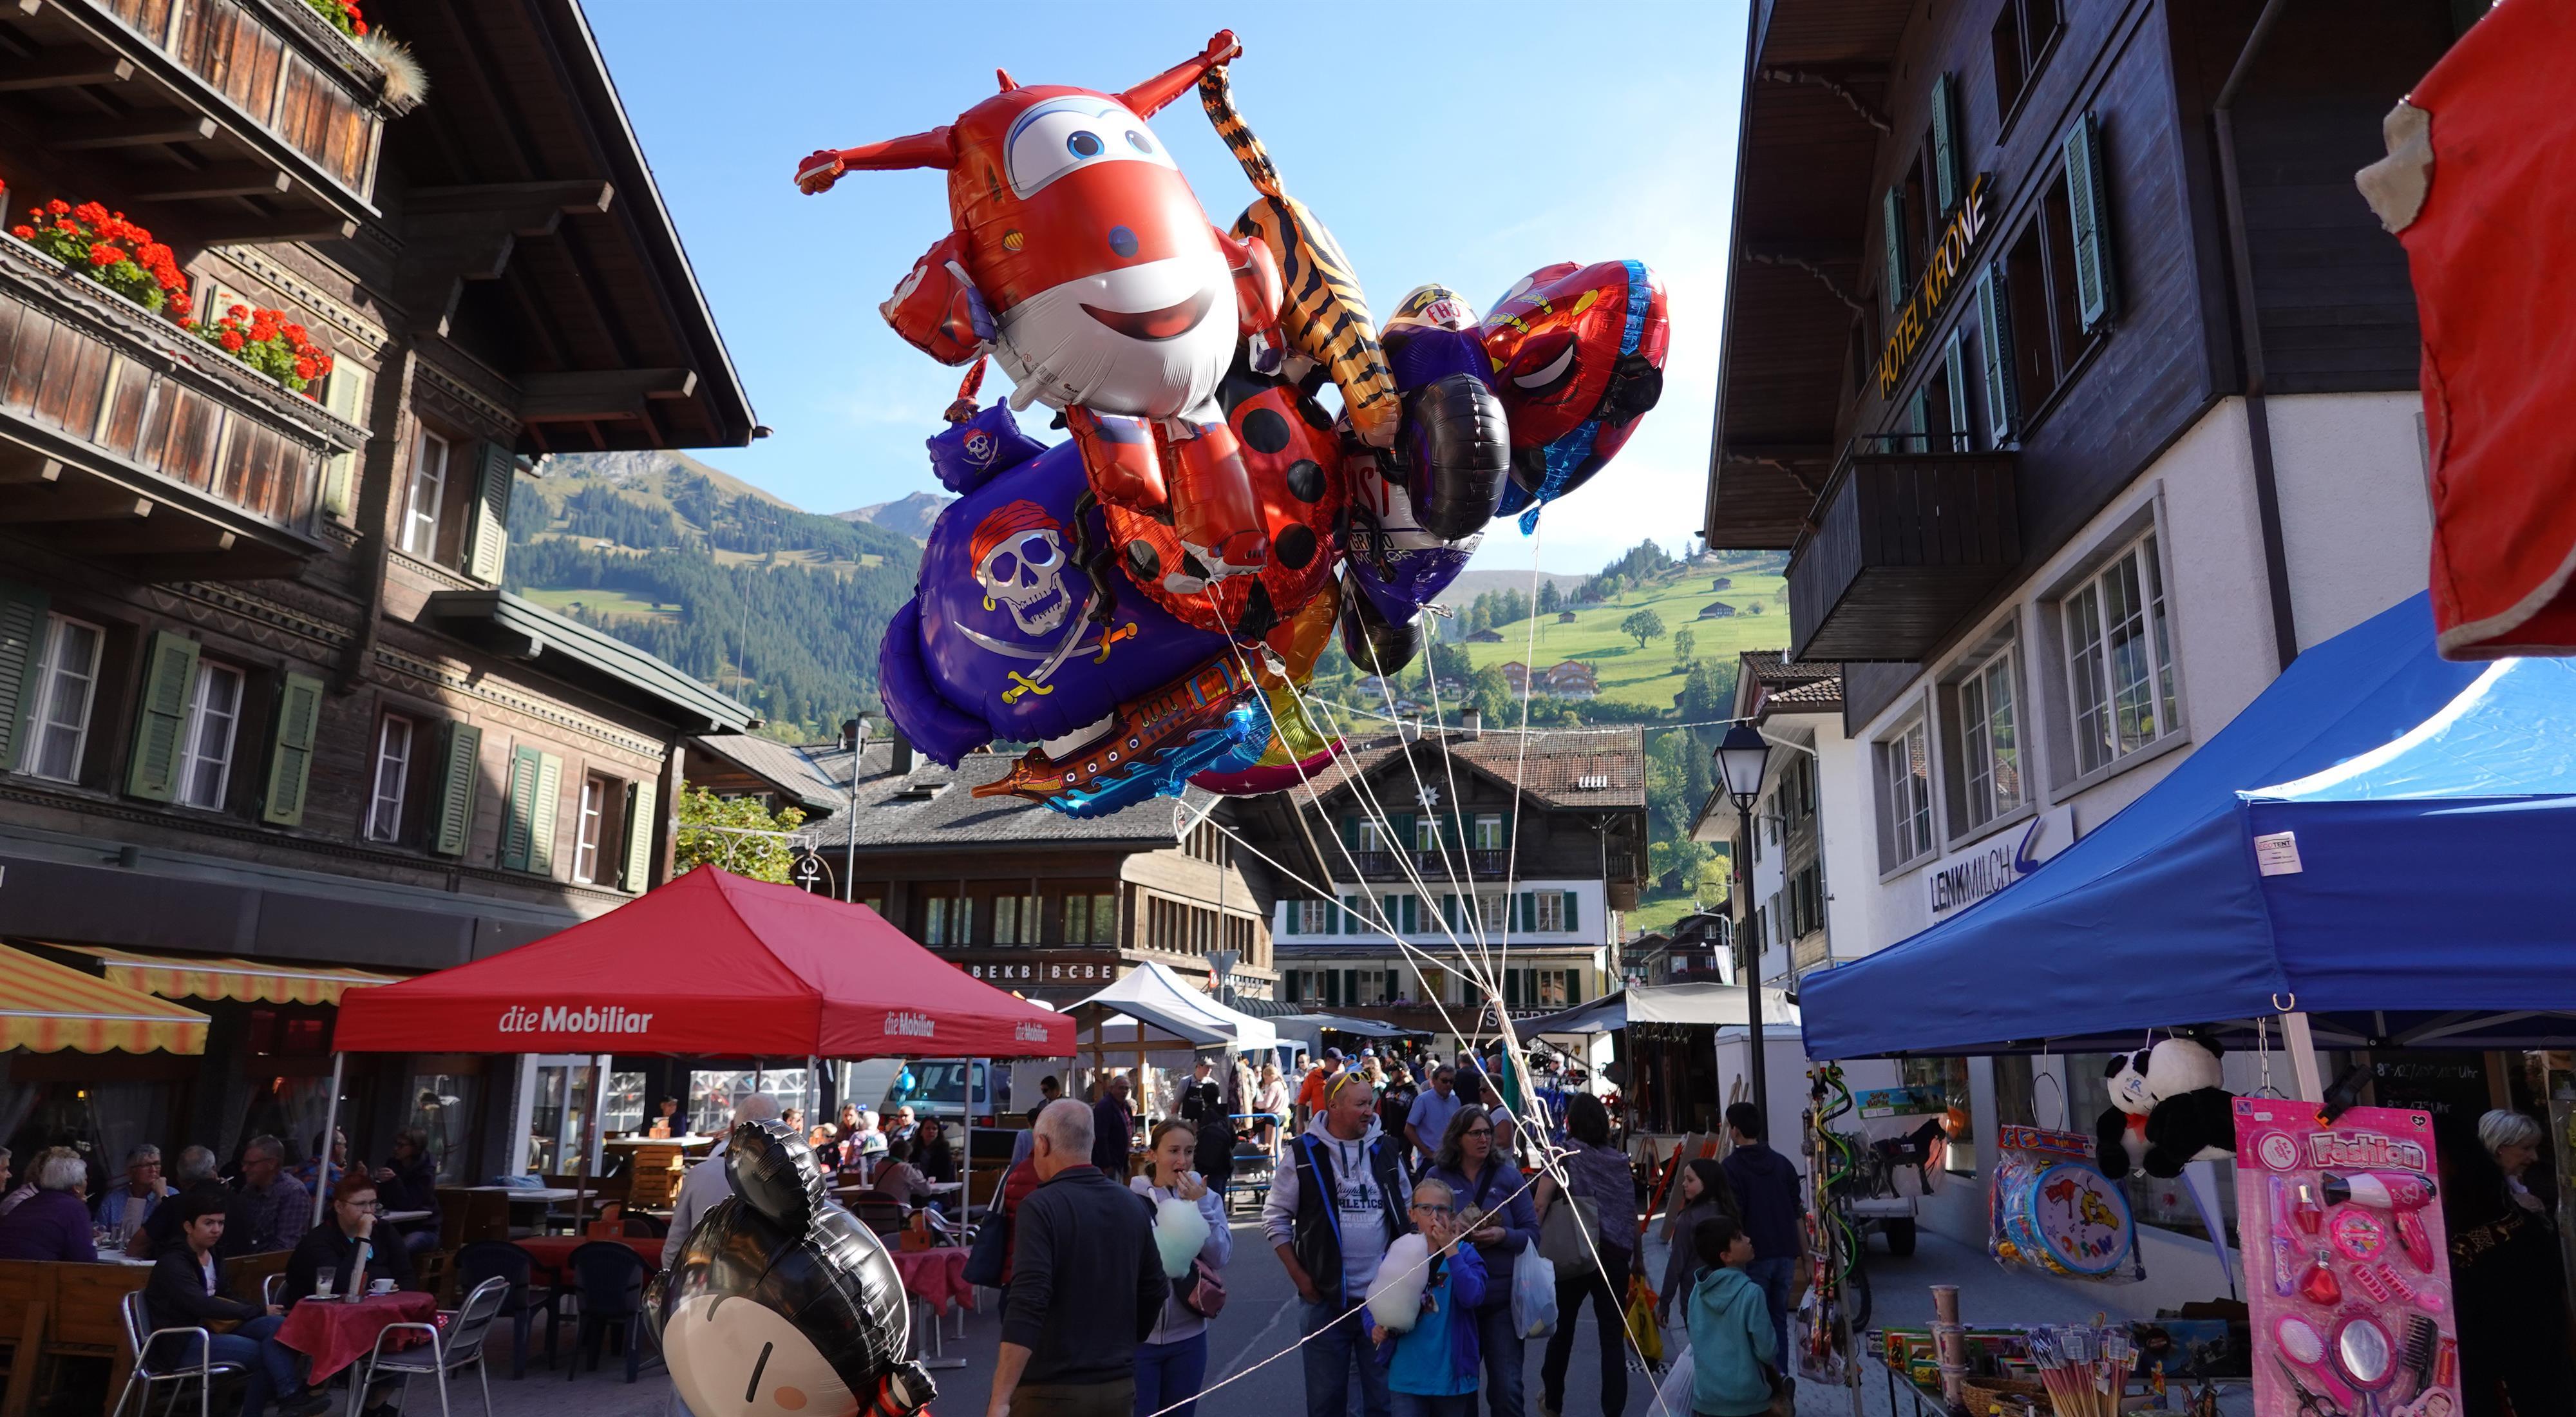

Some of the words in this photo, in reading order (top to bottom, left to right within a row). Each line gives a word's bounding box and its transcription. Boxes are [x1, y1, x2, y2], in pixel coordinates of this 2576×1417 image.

[1879, 298, 1924, 399] HOTEL
[1924, 174, 1986, 319] KRONE
[2259, 840, 2291, 850] ECOTENT
[972, 965, 1030, 978] BEKB
[1051, 965, 1111, 978] BCBE
[498, 1005, 539, 1032] die
[540, 1005, 654, 1034] Mobiliar
[884, 1011, 899, 1036] die
[899, 1012, 935, 1038] Mobiliar
[1015, 1020, 1025, 1041] die
[1025, 1022, 1048, 1042] Mobiliar
[2311, 1134, 2424, 1170] Fashion
